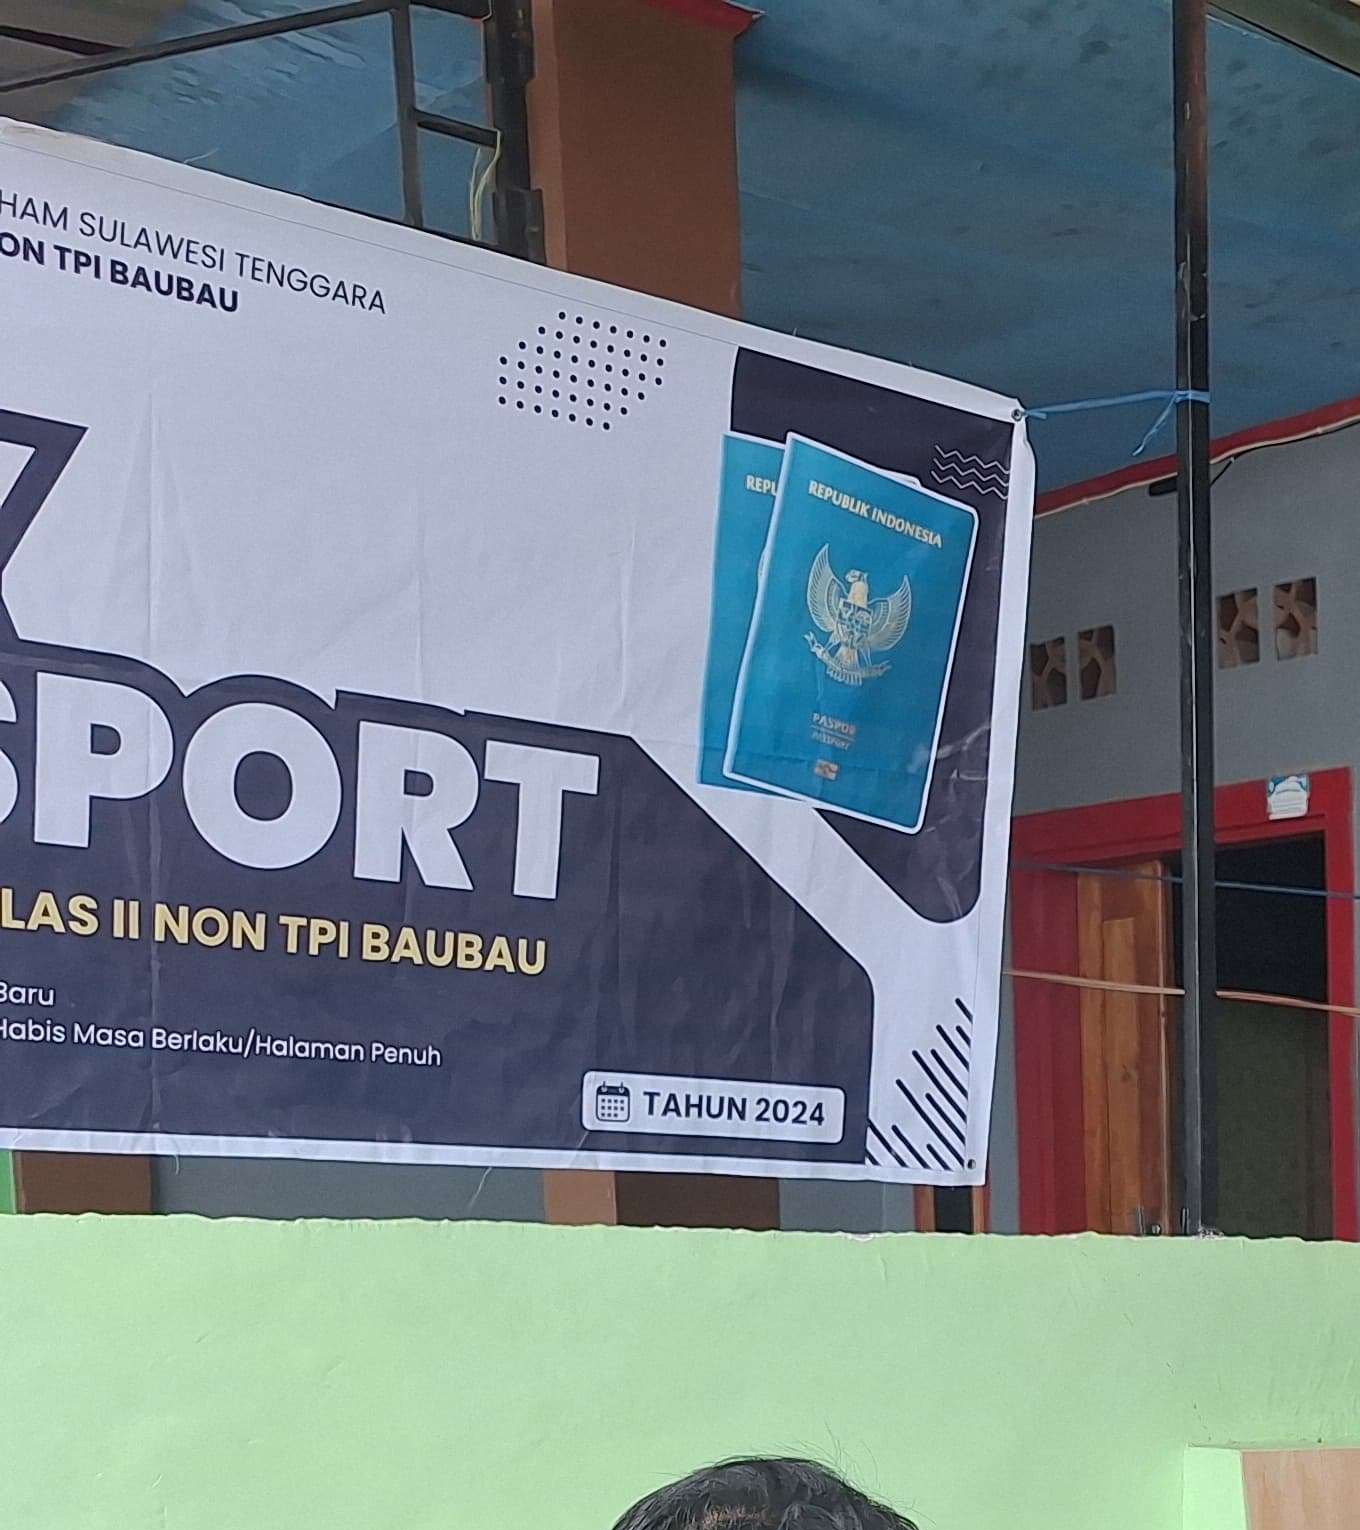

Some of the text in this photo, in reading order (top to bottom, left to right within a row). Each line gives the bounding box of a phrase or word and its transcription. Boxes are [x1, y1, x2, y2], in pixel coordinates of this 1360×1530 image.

[0, 188, 386, 314] HAM SULAWESI TENGGARA
[0, 231, 239, 313] ON TPI BAUBAU
[809, 480, 943, 548] REPUBLIK INDONESIA
[0, 671, 600, 900] PORT
[1, 887, 546, 975] LAS II NON TPI BAUBAU
[73, 1023, 144, 1047] Masa
[152, 1027, 365, 1061] Berlaku/Halaman
[371, 1042, 441, 1066] Penuh
[643, 1090, 825, 1126] TAHUN 2024
